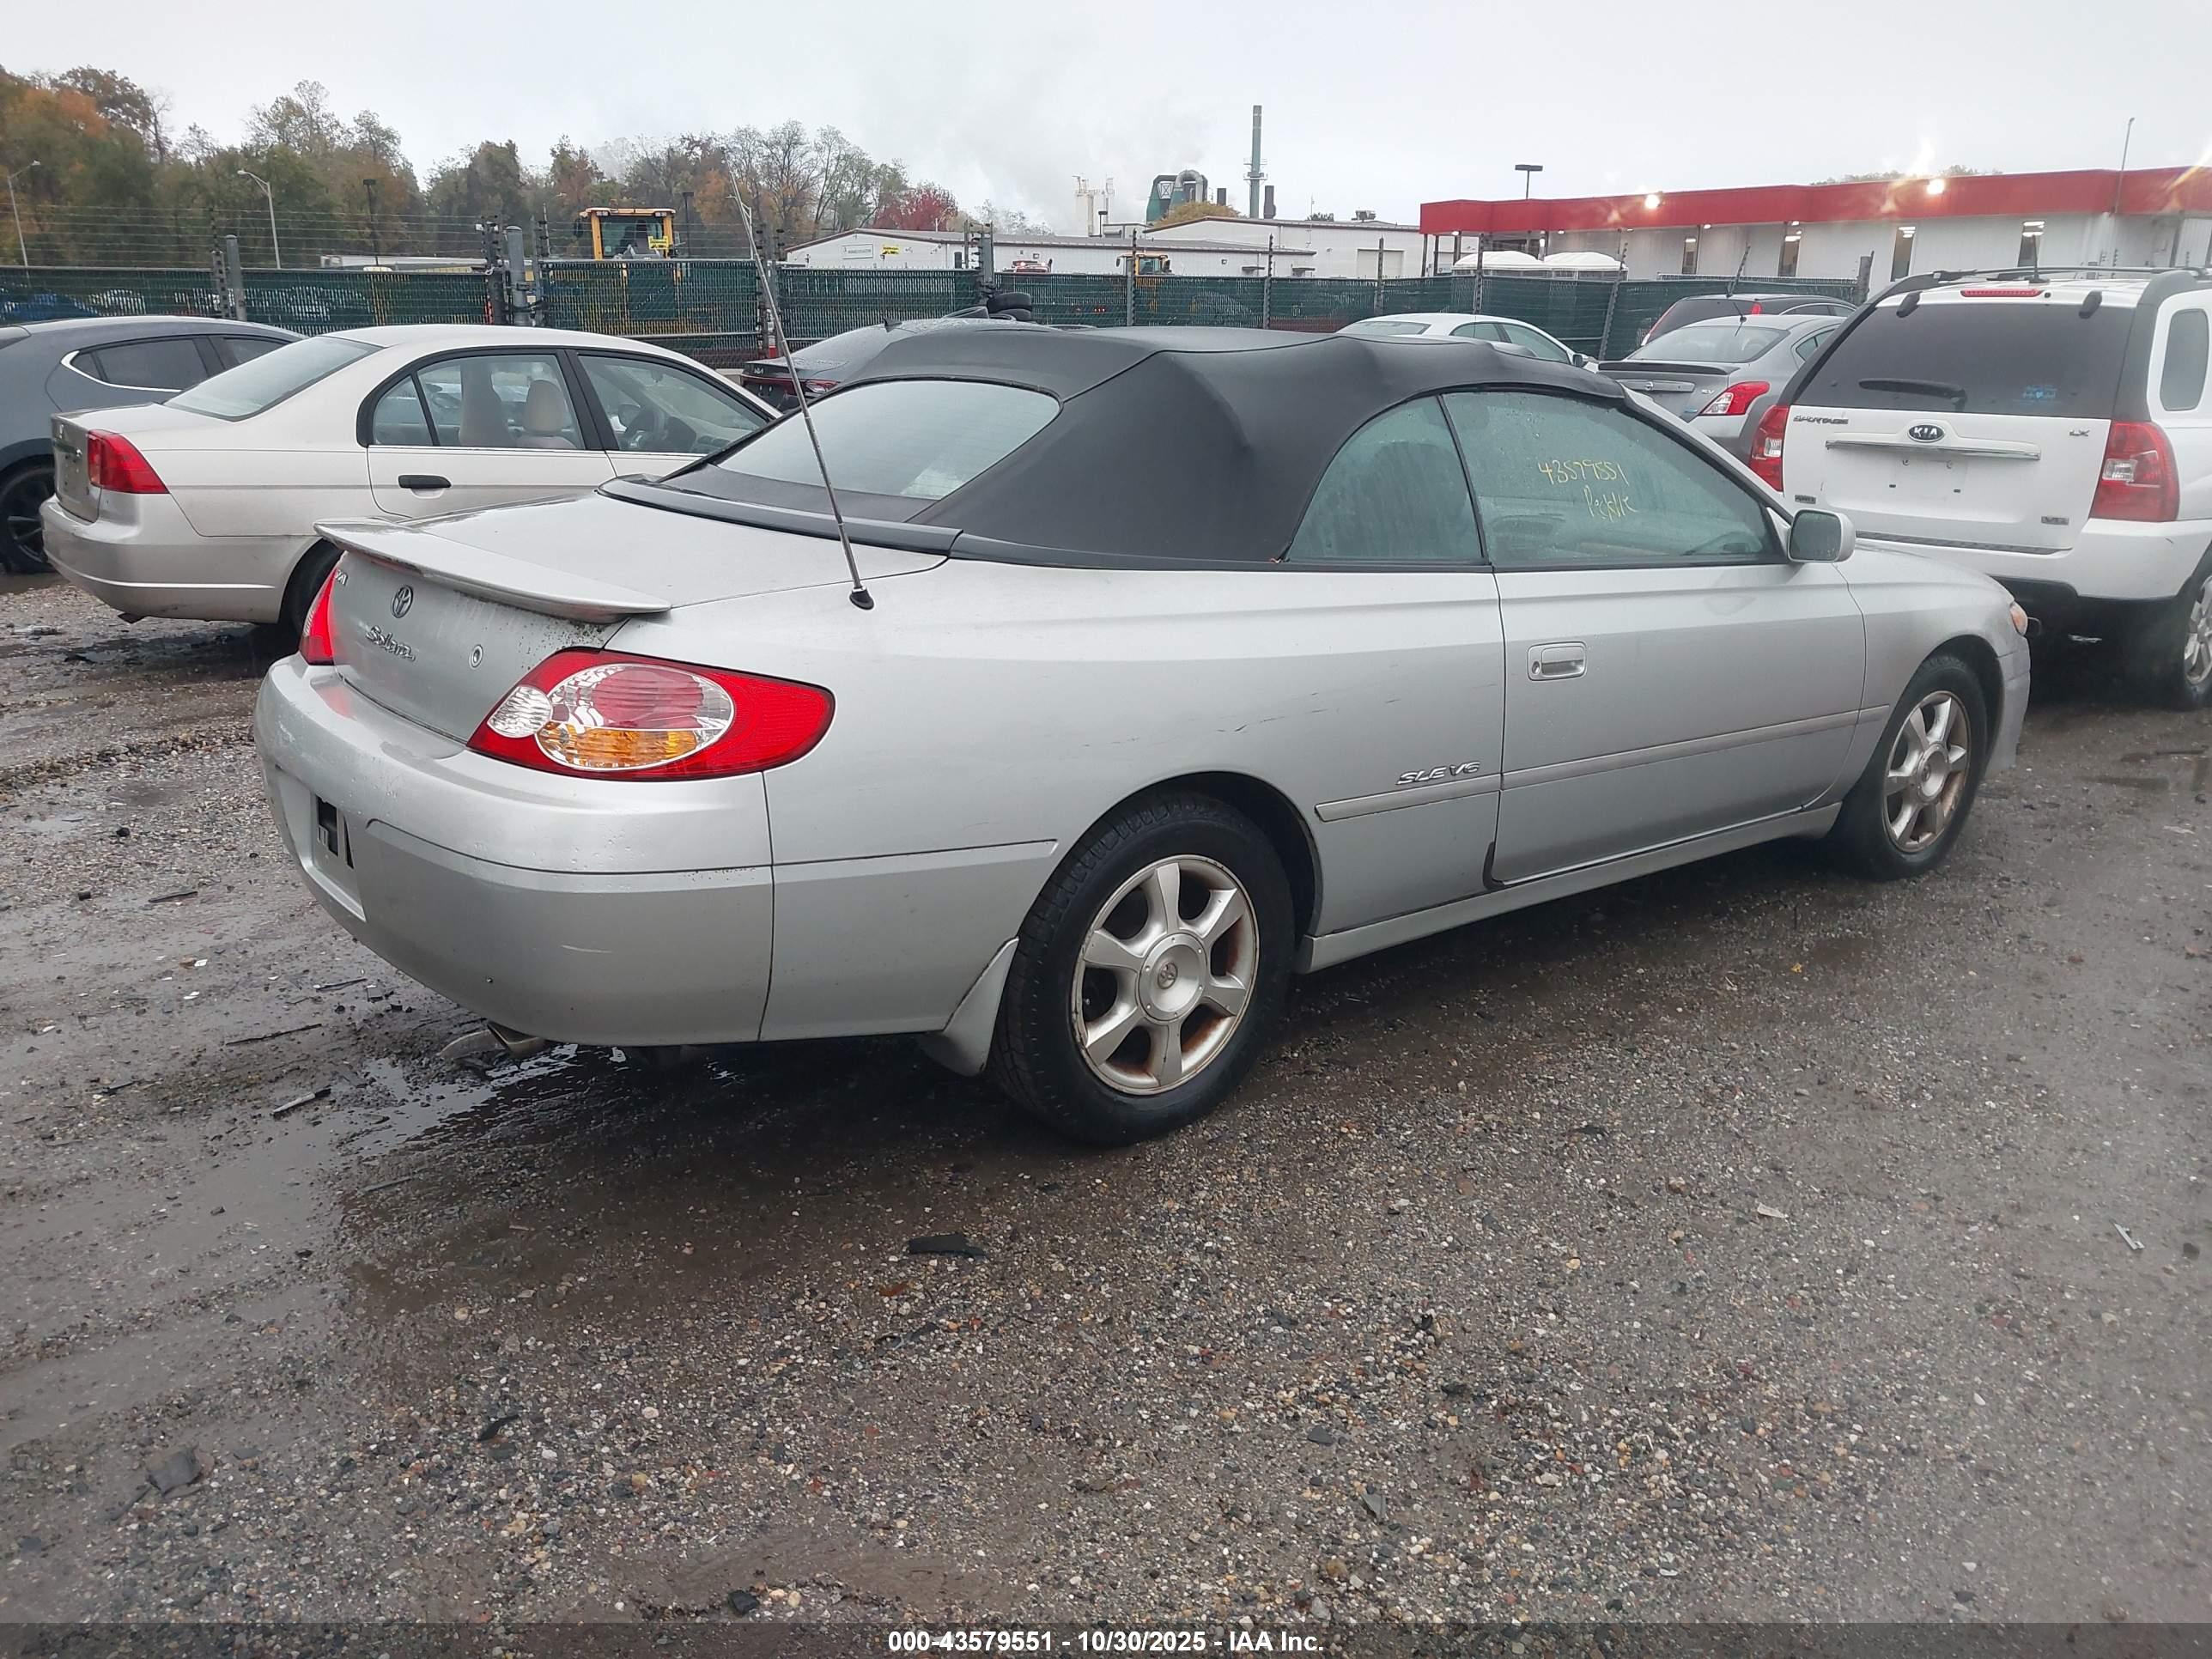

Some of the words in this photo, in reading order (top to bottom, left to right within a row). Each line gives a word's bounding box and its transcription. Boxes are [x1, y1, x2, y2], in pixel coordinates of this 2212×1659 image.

[1913, 427, 1938, 437] KIA
[1538, 459, 1629, 486] 43579551
[365, 625, 416, 662] Solara
[1395, 766, 1447, 785] SLE
[1449, 761, 1480, 776] V6
